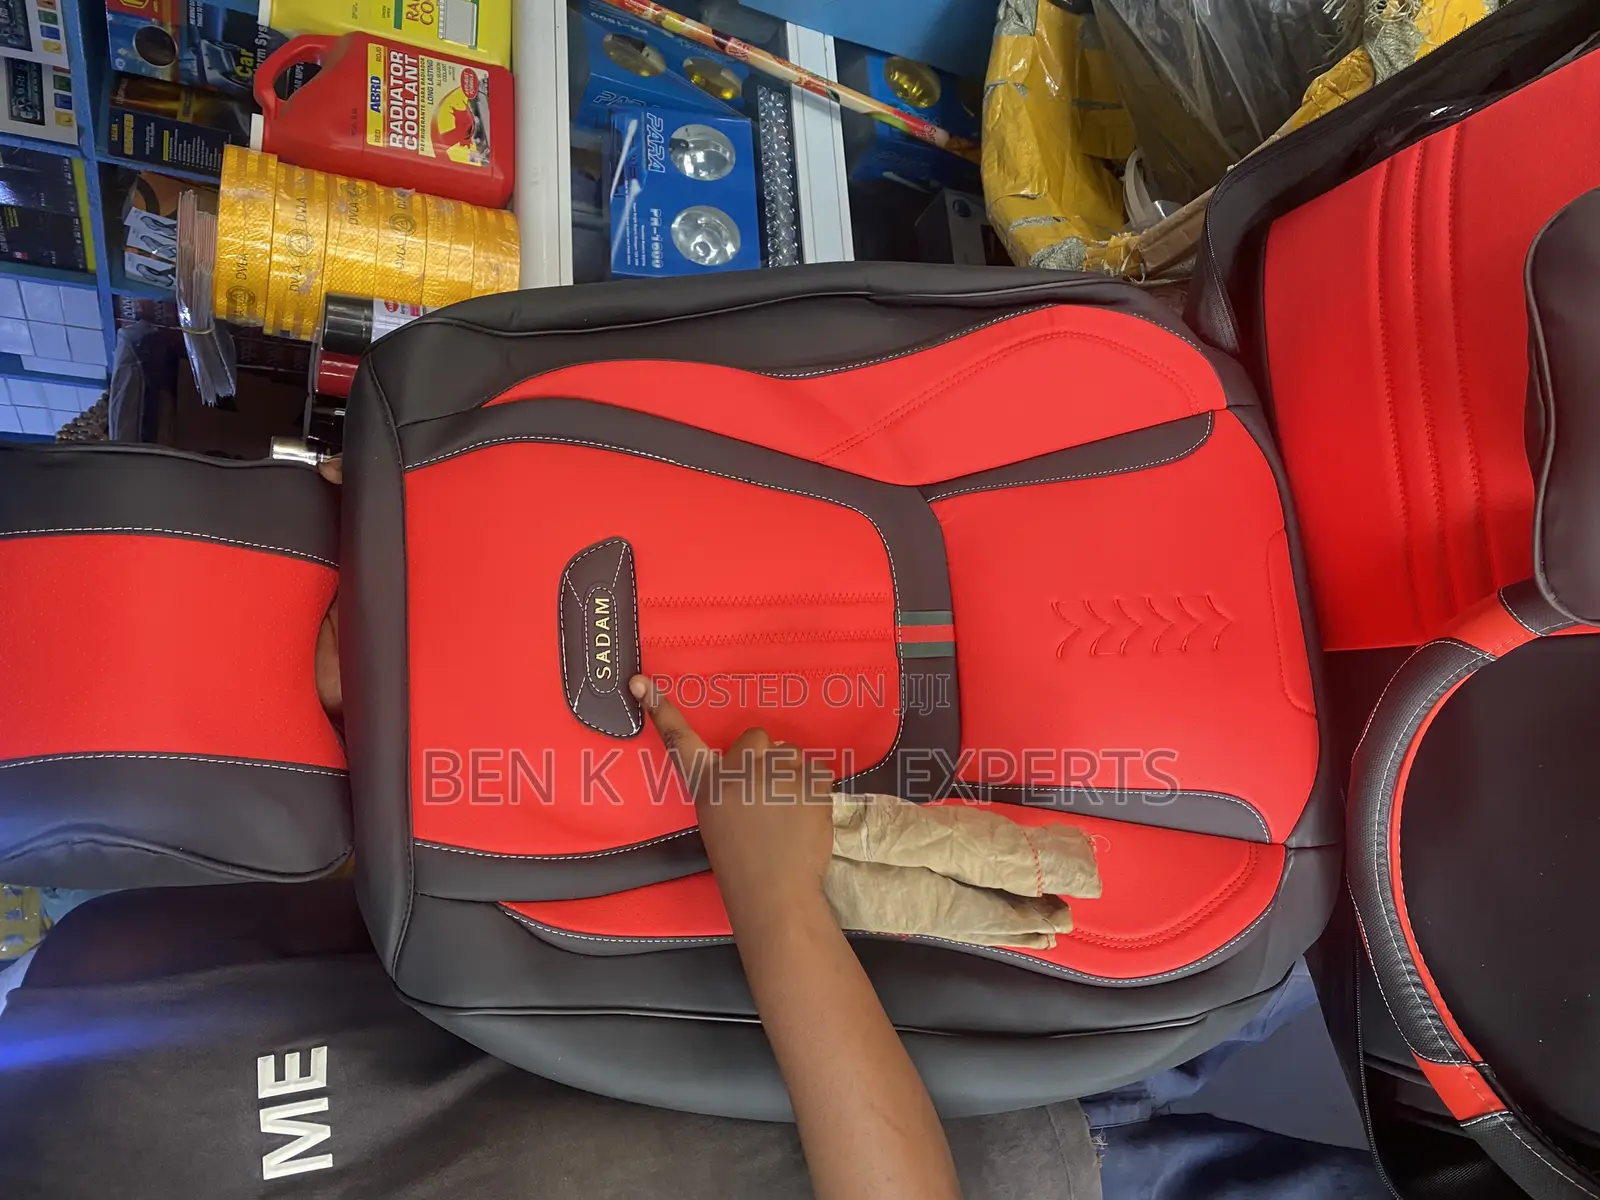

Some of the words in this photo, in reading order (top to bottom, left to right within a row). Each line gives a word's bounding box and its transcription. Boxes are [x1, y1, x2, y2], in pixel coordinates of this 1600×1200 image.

[405, 0, 420, 21] RA
[255, 26, 270, 46] Sys
[236, 48, 254, 77] Car
[370, 75, 381, 114] ABRO
[390, 50, 404, 148] RADIATOR
[404, 53, 417, 150] COOLANT
[646, 112, 666, 173] PARA
[294, 197, 308, 222] DVLA
[348, 202, 359, 225] DVLA
[235, 252, 247, 280] DVLA
[594, 597, 612, 680] SADAM
[257, 1046, 333, 1180] ME
